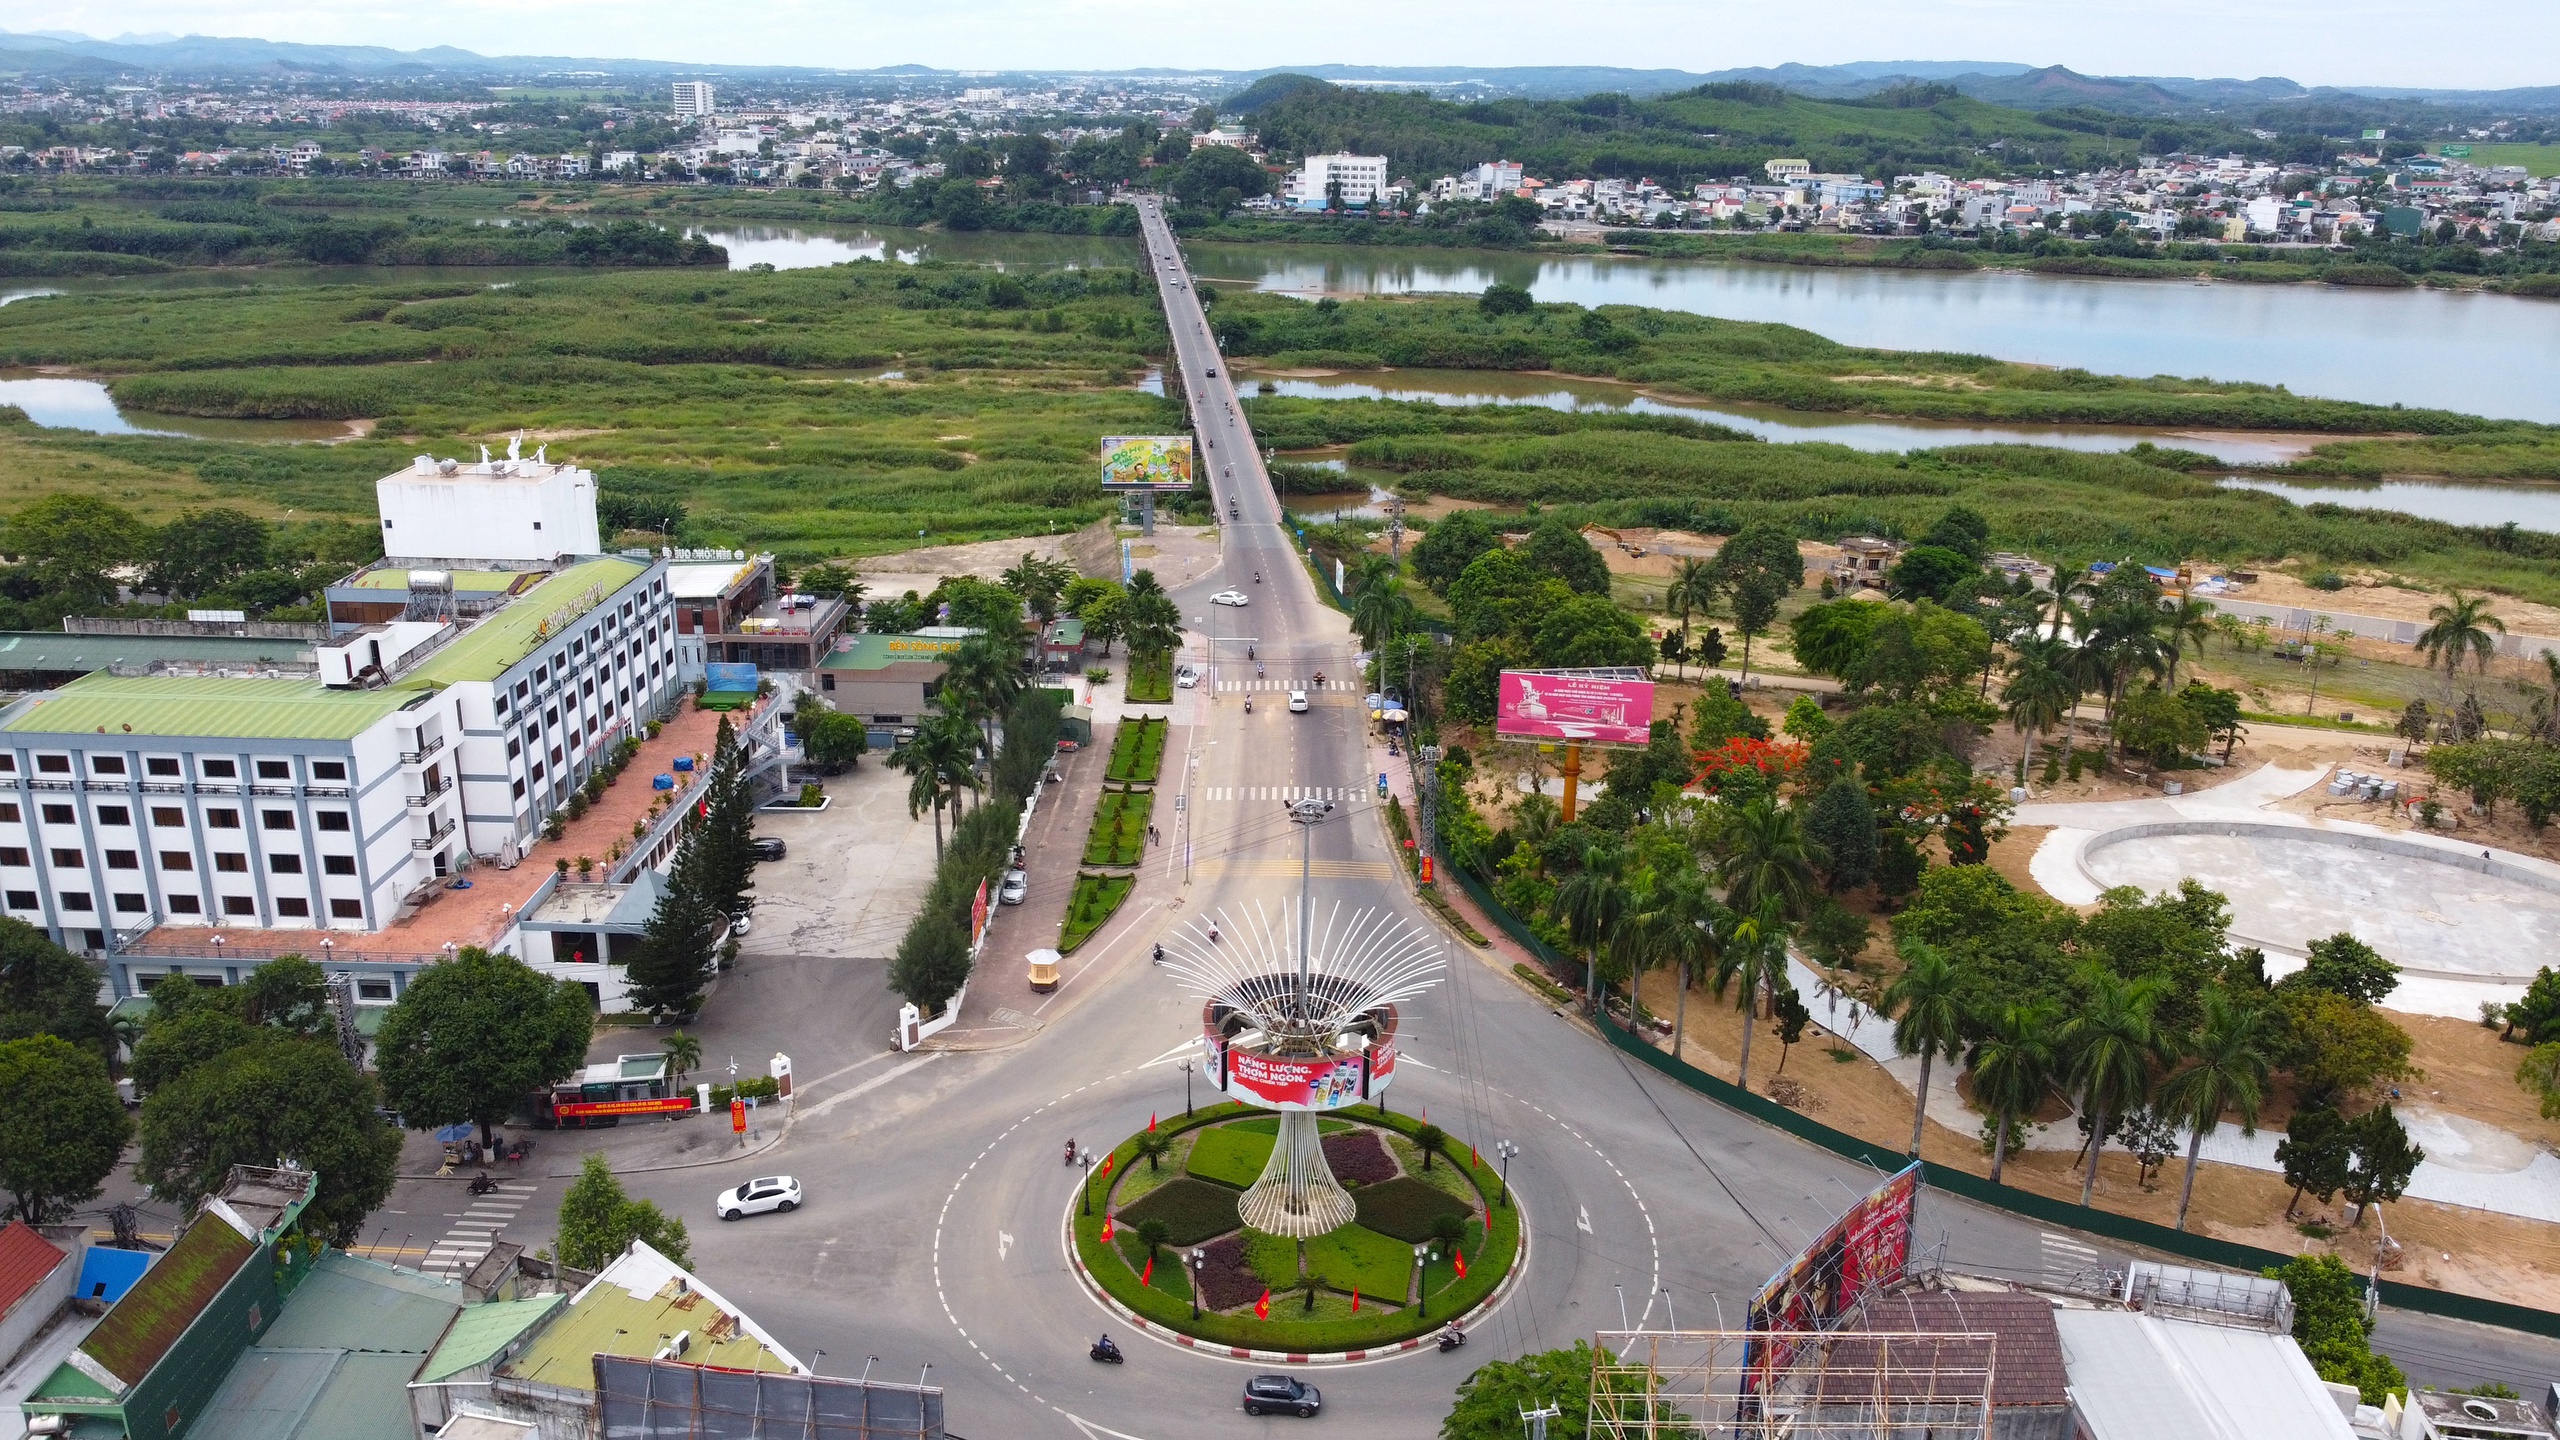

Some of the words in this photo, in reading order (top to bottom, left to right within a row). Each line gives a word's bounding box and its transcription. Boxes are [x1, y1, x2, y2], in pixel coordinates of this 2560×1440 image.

[889, 637, 909, 651] BẾN
[910, 639, 938, 651] SÔNG
[1238, 1055, 1267, 1070] NĂNG
[1269, 1063, 1312, 1075] LƯỢNG.
[1238, 1063, 1268, 1079] THƠM
[1270, 1072, 1307, 1083] NGON.
